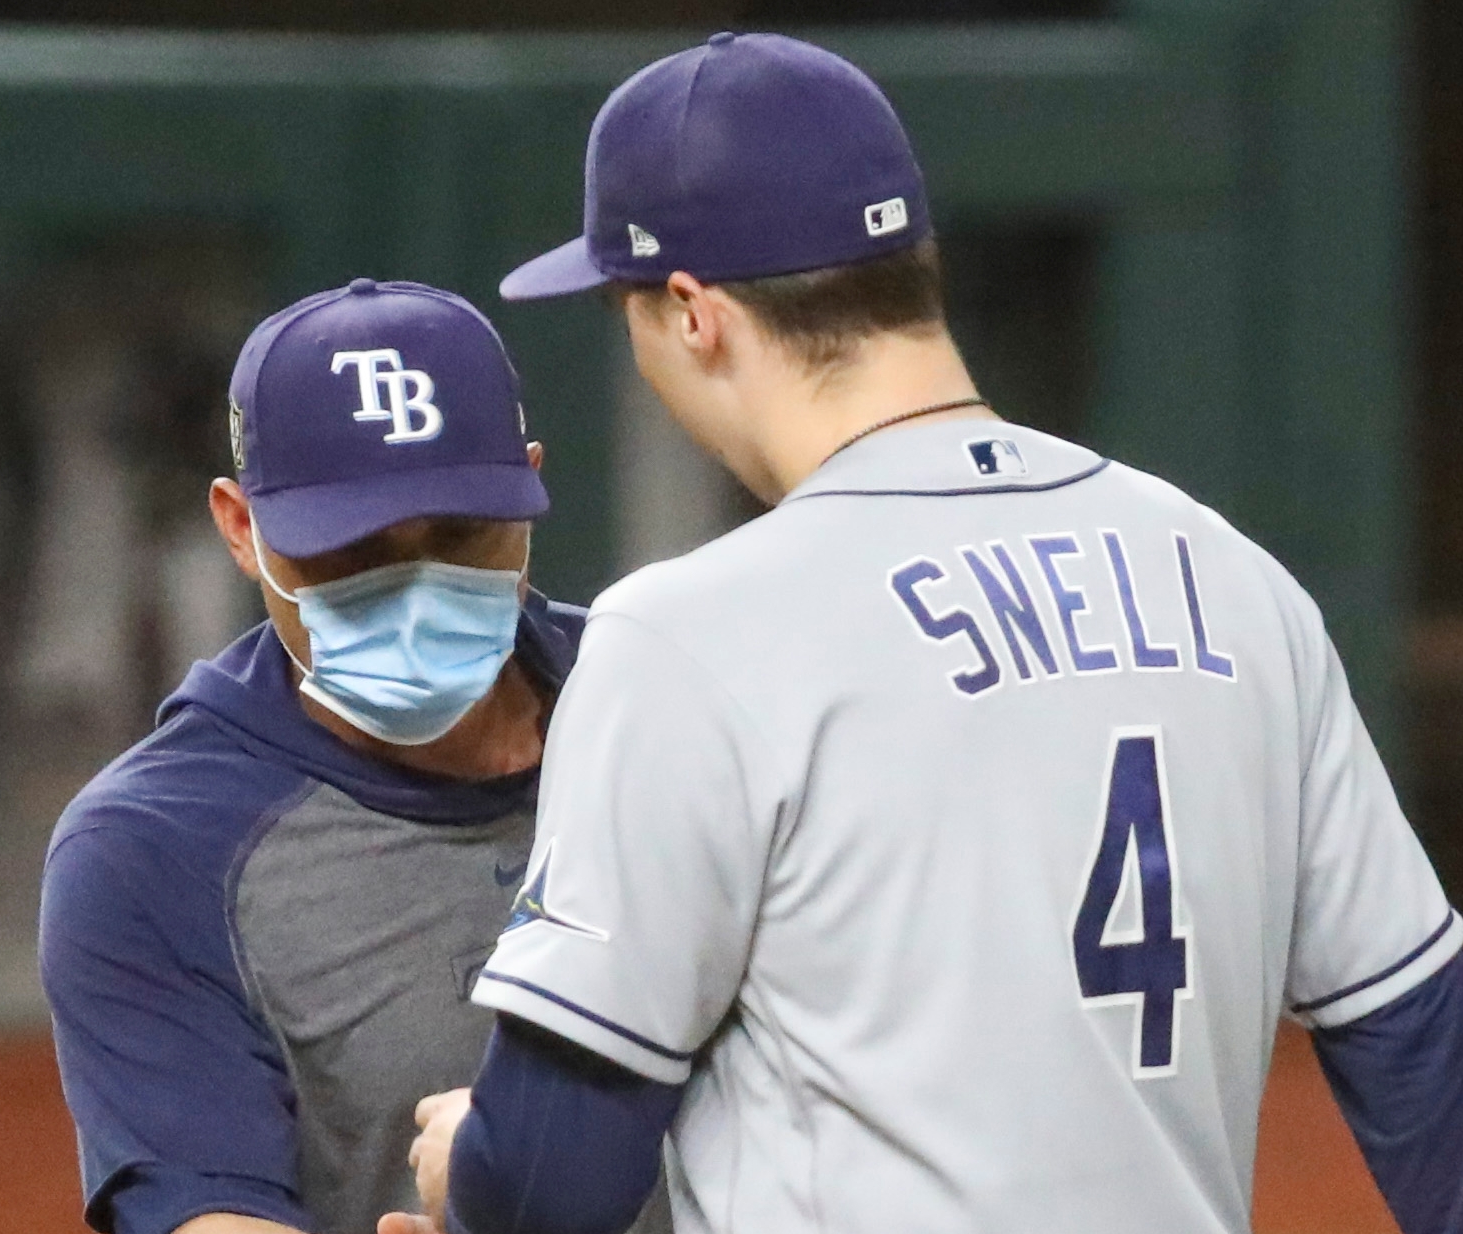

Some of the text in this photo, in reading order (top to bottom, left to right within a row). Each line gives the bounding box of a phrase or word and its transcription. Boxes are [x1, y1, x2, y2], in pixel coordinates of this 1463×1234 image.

[331, 348, 444, 445] TB
[887, 527, 1237, 699] SNELL
[1068, 724, 1194, 1079] 4
